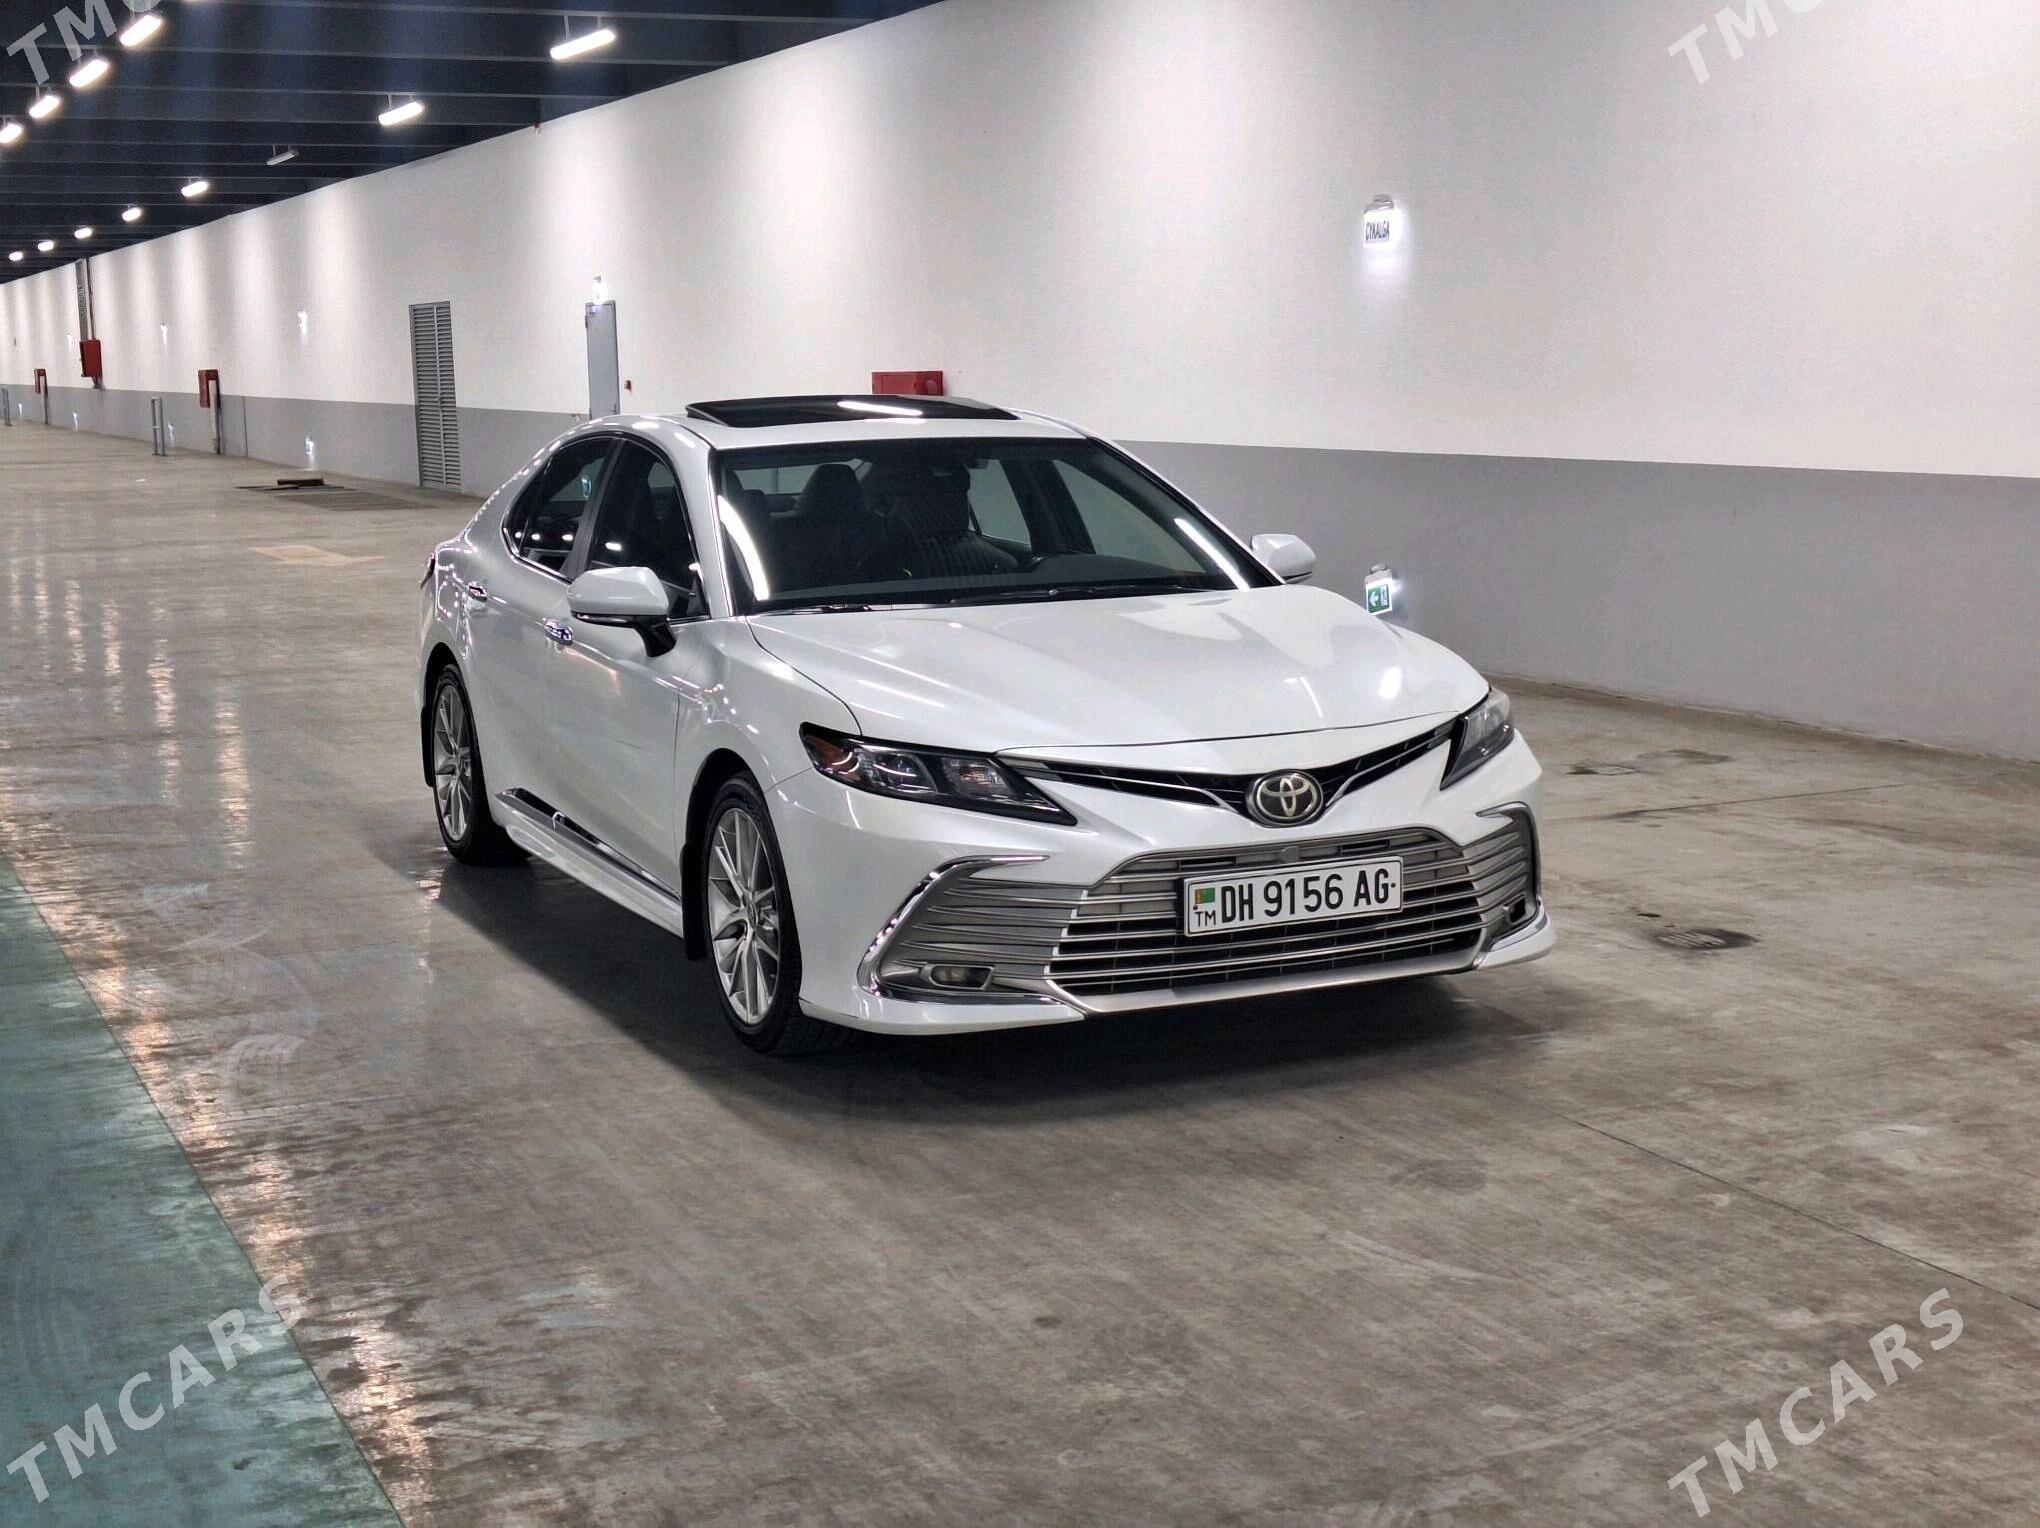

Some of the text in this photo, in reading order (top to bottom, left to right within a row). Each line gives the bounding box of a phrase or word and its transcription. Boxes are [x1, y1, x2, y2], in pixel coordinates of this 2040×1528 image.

[1220, 868, 1389, 923] DH 9156 AG
[1195, 910, 1216, 927] TM
